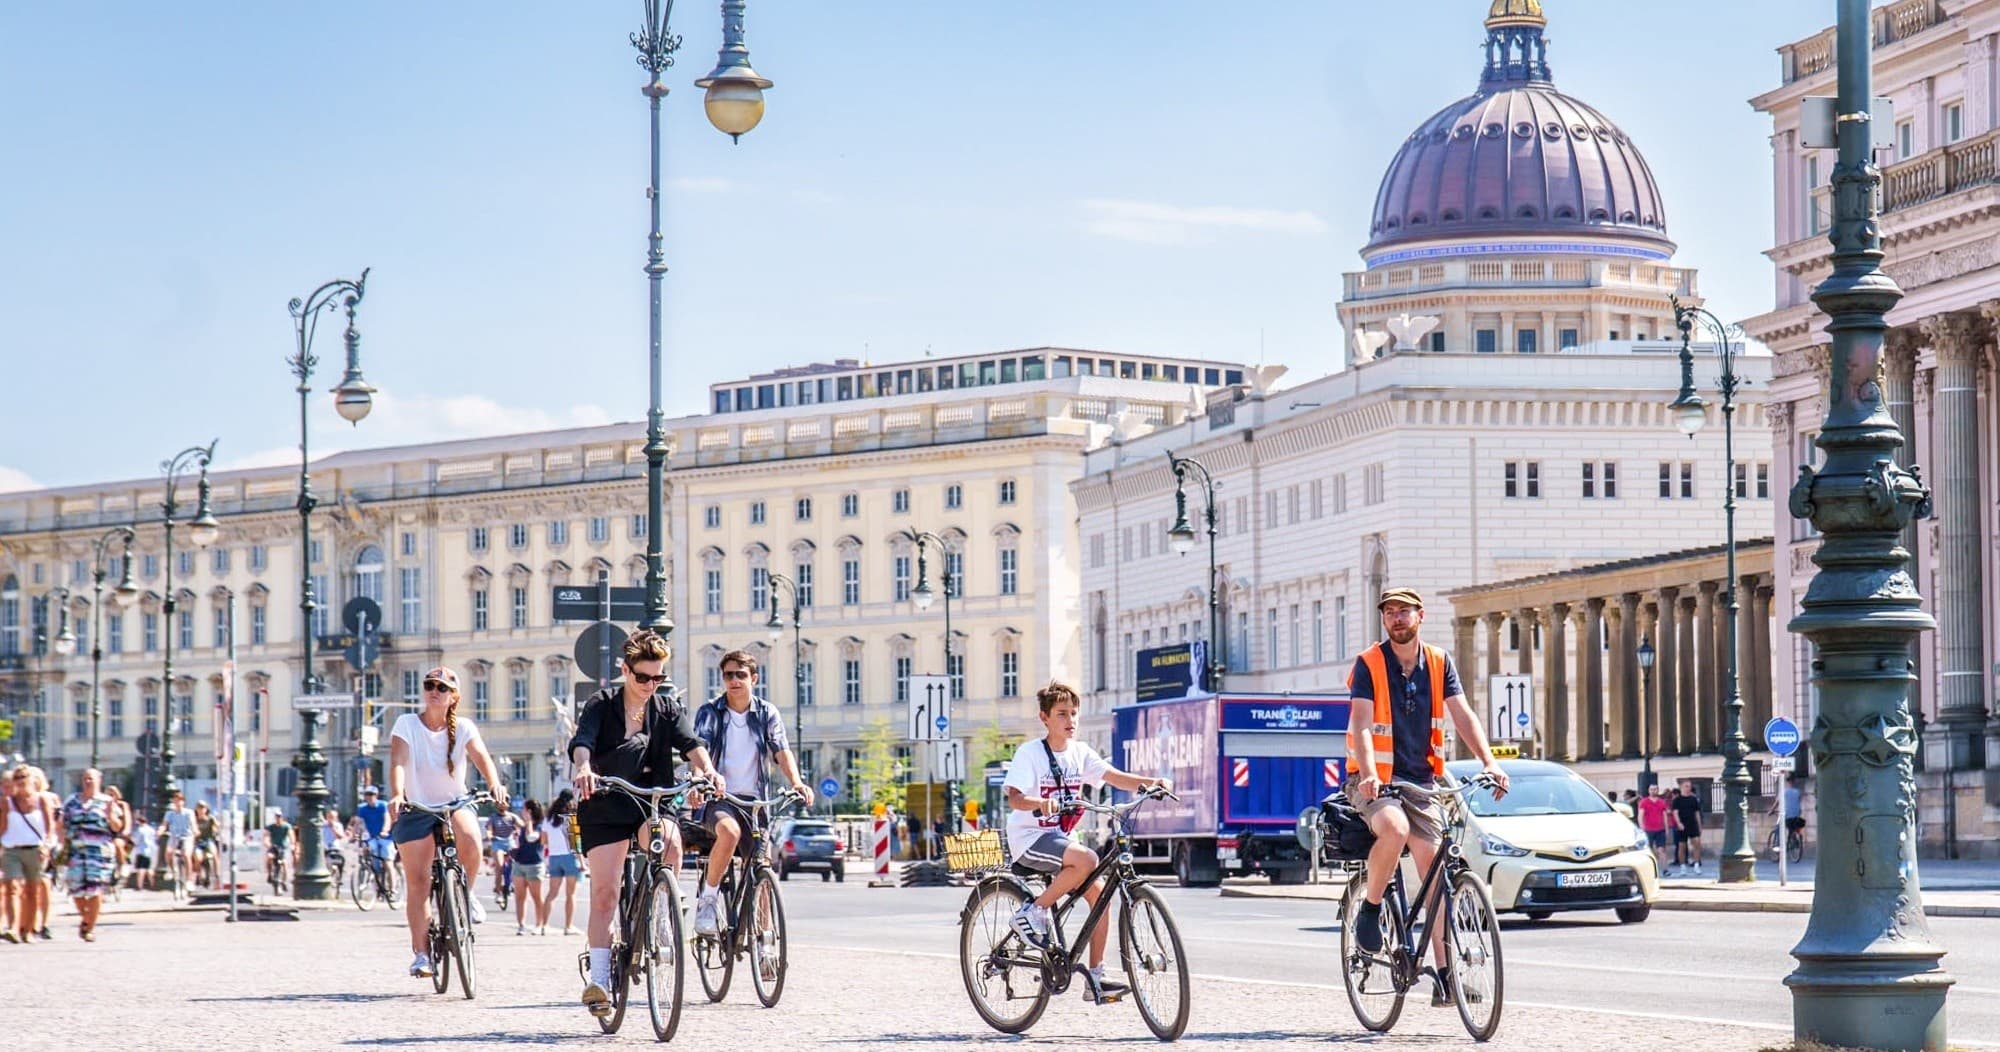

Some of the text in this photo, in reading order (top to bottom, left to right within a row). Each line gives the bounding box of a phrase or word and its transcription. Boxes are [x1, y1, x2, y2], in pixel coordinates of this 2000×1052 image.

[1122, 733, 1199, 772] TRANS CLEAN
[1774, 760, 1792, 768] Ende
